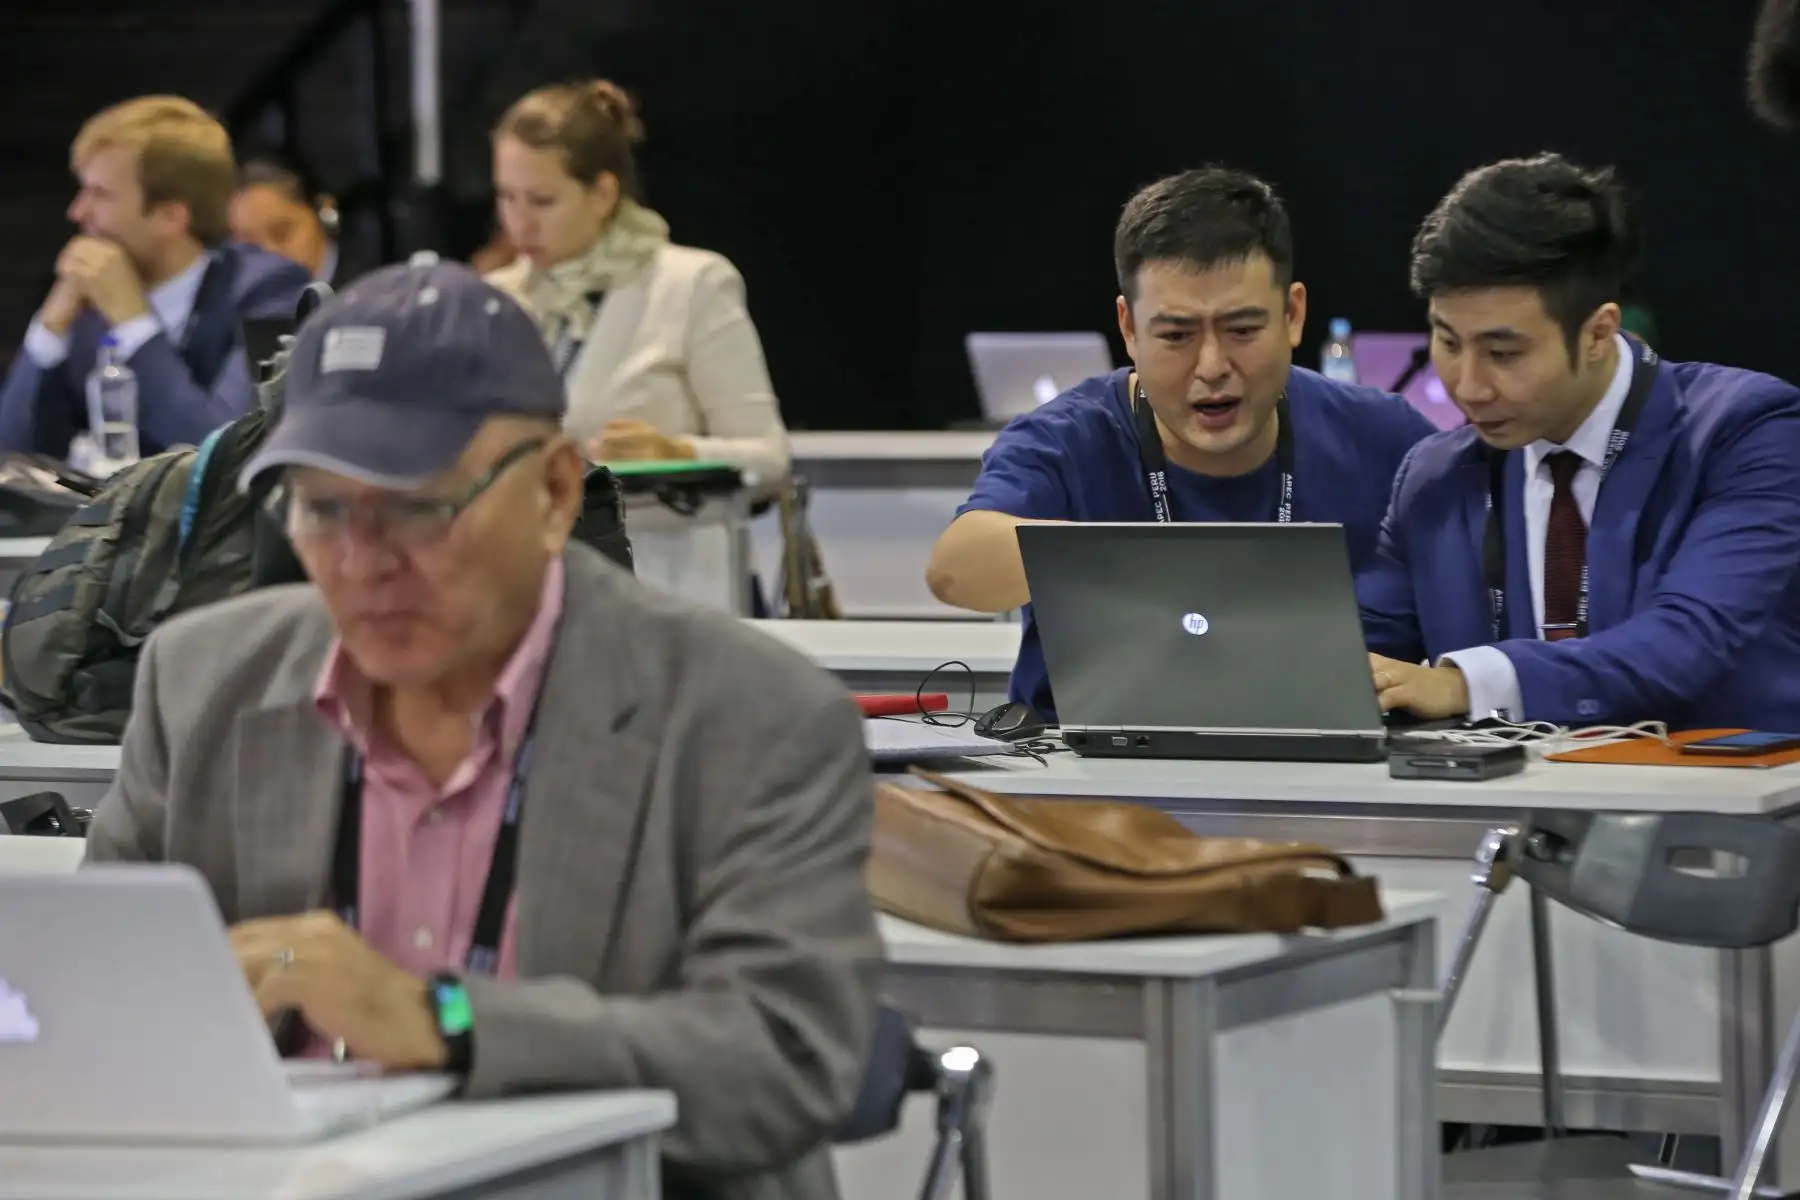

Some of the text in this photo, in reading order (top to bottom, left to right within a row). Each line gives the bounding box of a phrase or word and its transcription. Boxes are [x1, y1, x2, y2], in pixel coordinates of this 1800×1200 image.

[1149, 472, 1160, 498] PERU
[1157, 471, 1168, 492] 2016
[1285, 473, 1293, 500] APEC
[1190, 613, 1204, 634] hp
